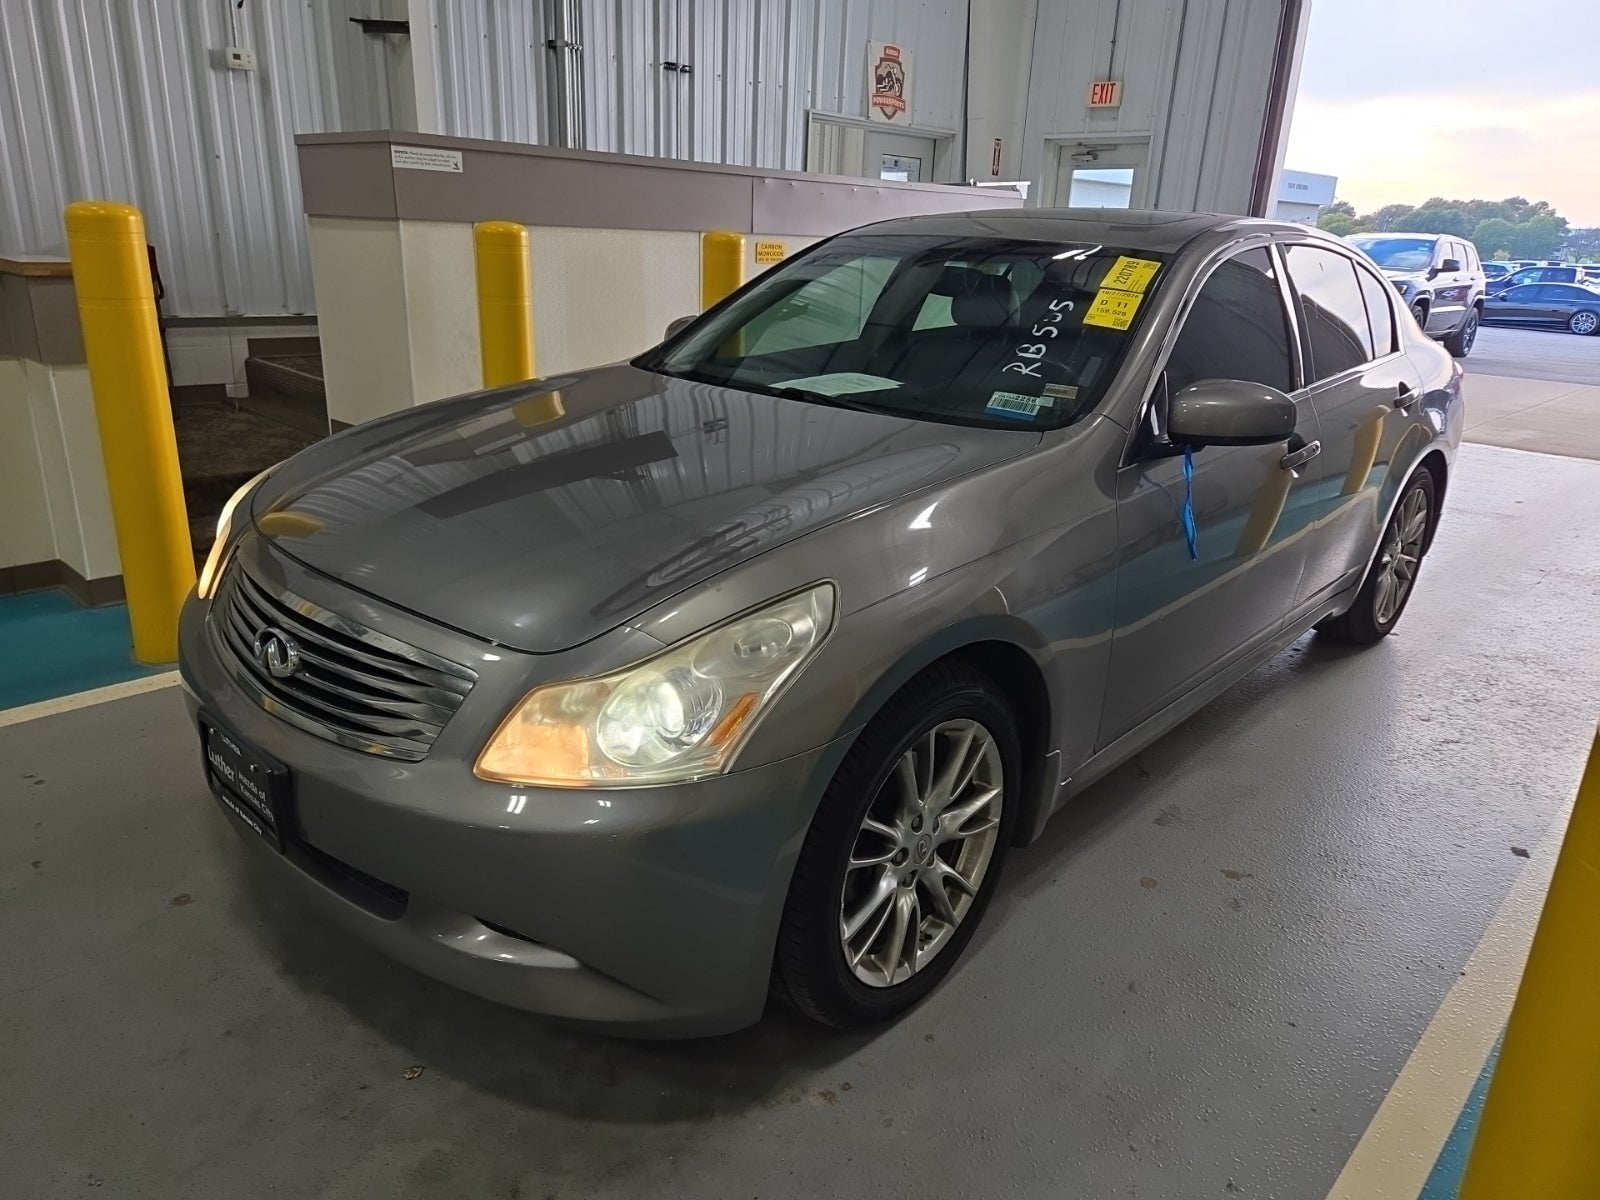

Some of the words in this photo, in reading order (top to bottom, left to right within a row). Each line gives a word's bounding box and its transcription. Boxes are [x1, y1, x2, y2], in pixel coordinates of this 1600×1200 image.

[872, 96, 904, 109] POWERSPORTS
[1091, 82, 1116, 104] EXIT
[1113, 260, 1140, 285] 220789
[1116, 301, 1128, 309] 11
[208, 745, 235, 782] Luther
[238, 770, 258, 795] Mazda
[258, 791, 266, 802] of
[261, 803, 274, 822] City
